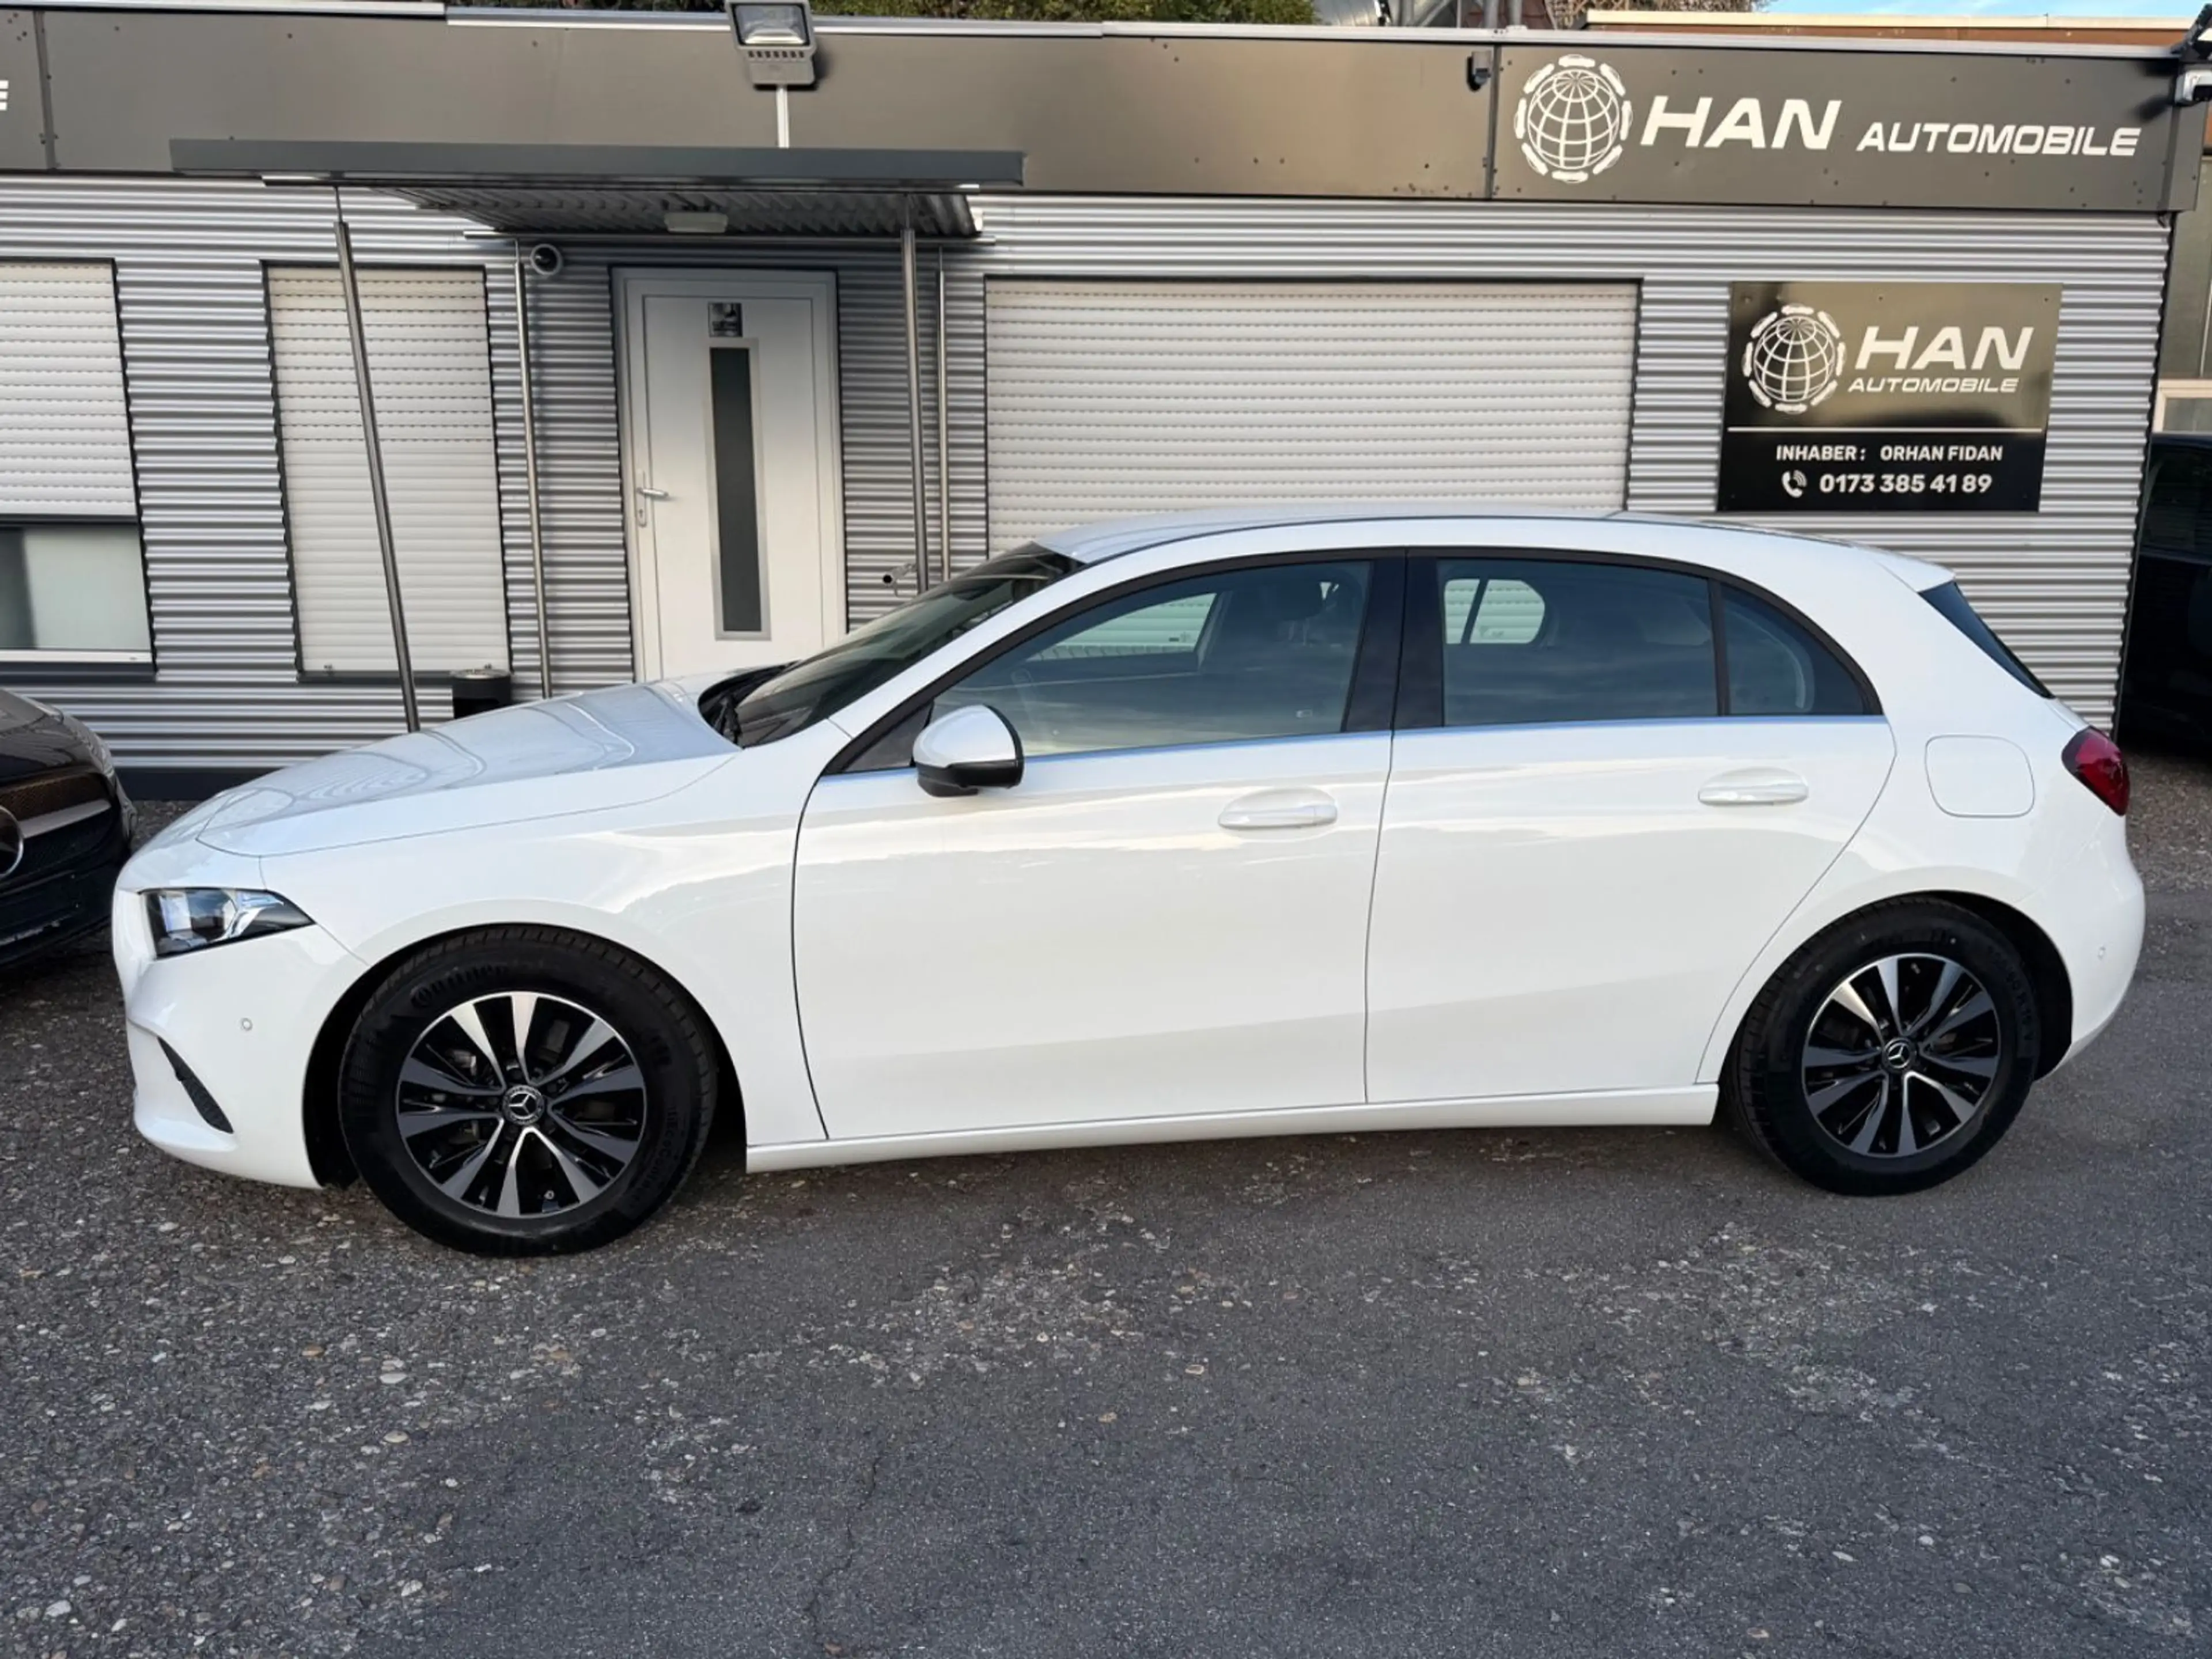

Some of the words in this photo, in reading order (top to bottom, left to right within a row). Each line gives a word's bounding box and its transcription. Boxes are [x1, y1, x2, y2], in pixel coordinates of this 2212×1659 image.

[1639, 94, 1843, 150] HAN
[1855, 121, 2142, 156] AUTOMOBILE
[1854, 325, 2034, 370] HAN
[1847, 377, 2020, 393] AUTOMOBILE
[1880, 445, 1944, 461] ORHAN
[1947, 445, 2003, 461] FIDAN
[1819, 474, 1875, 493] 0173
[1879, 474, 1926, 493] 385
